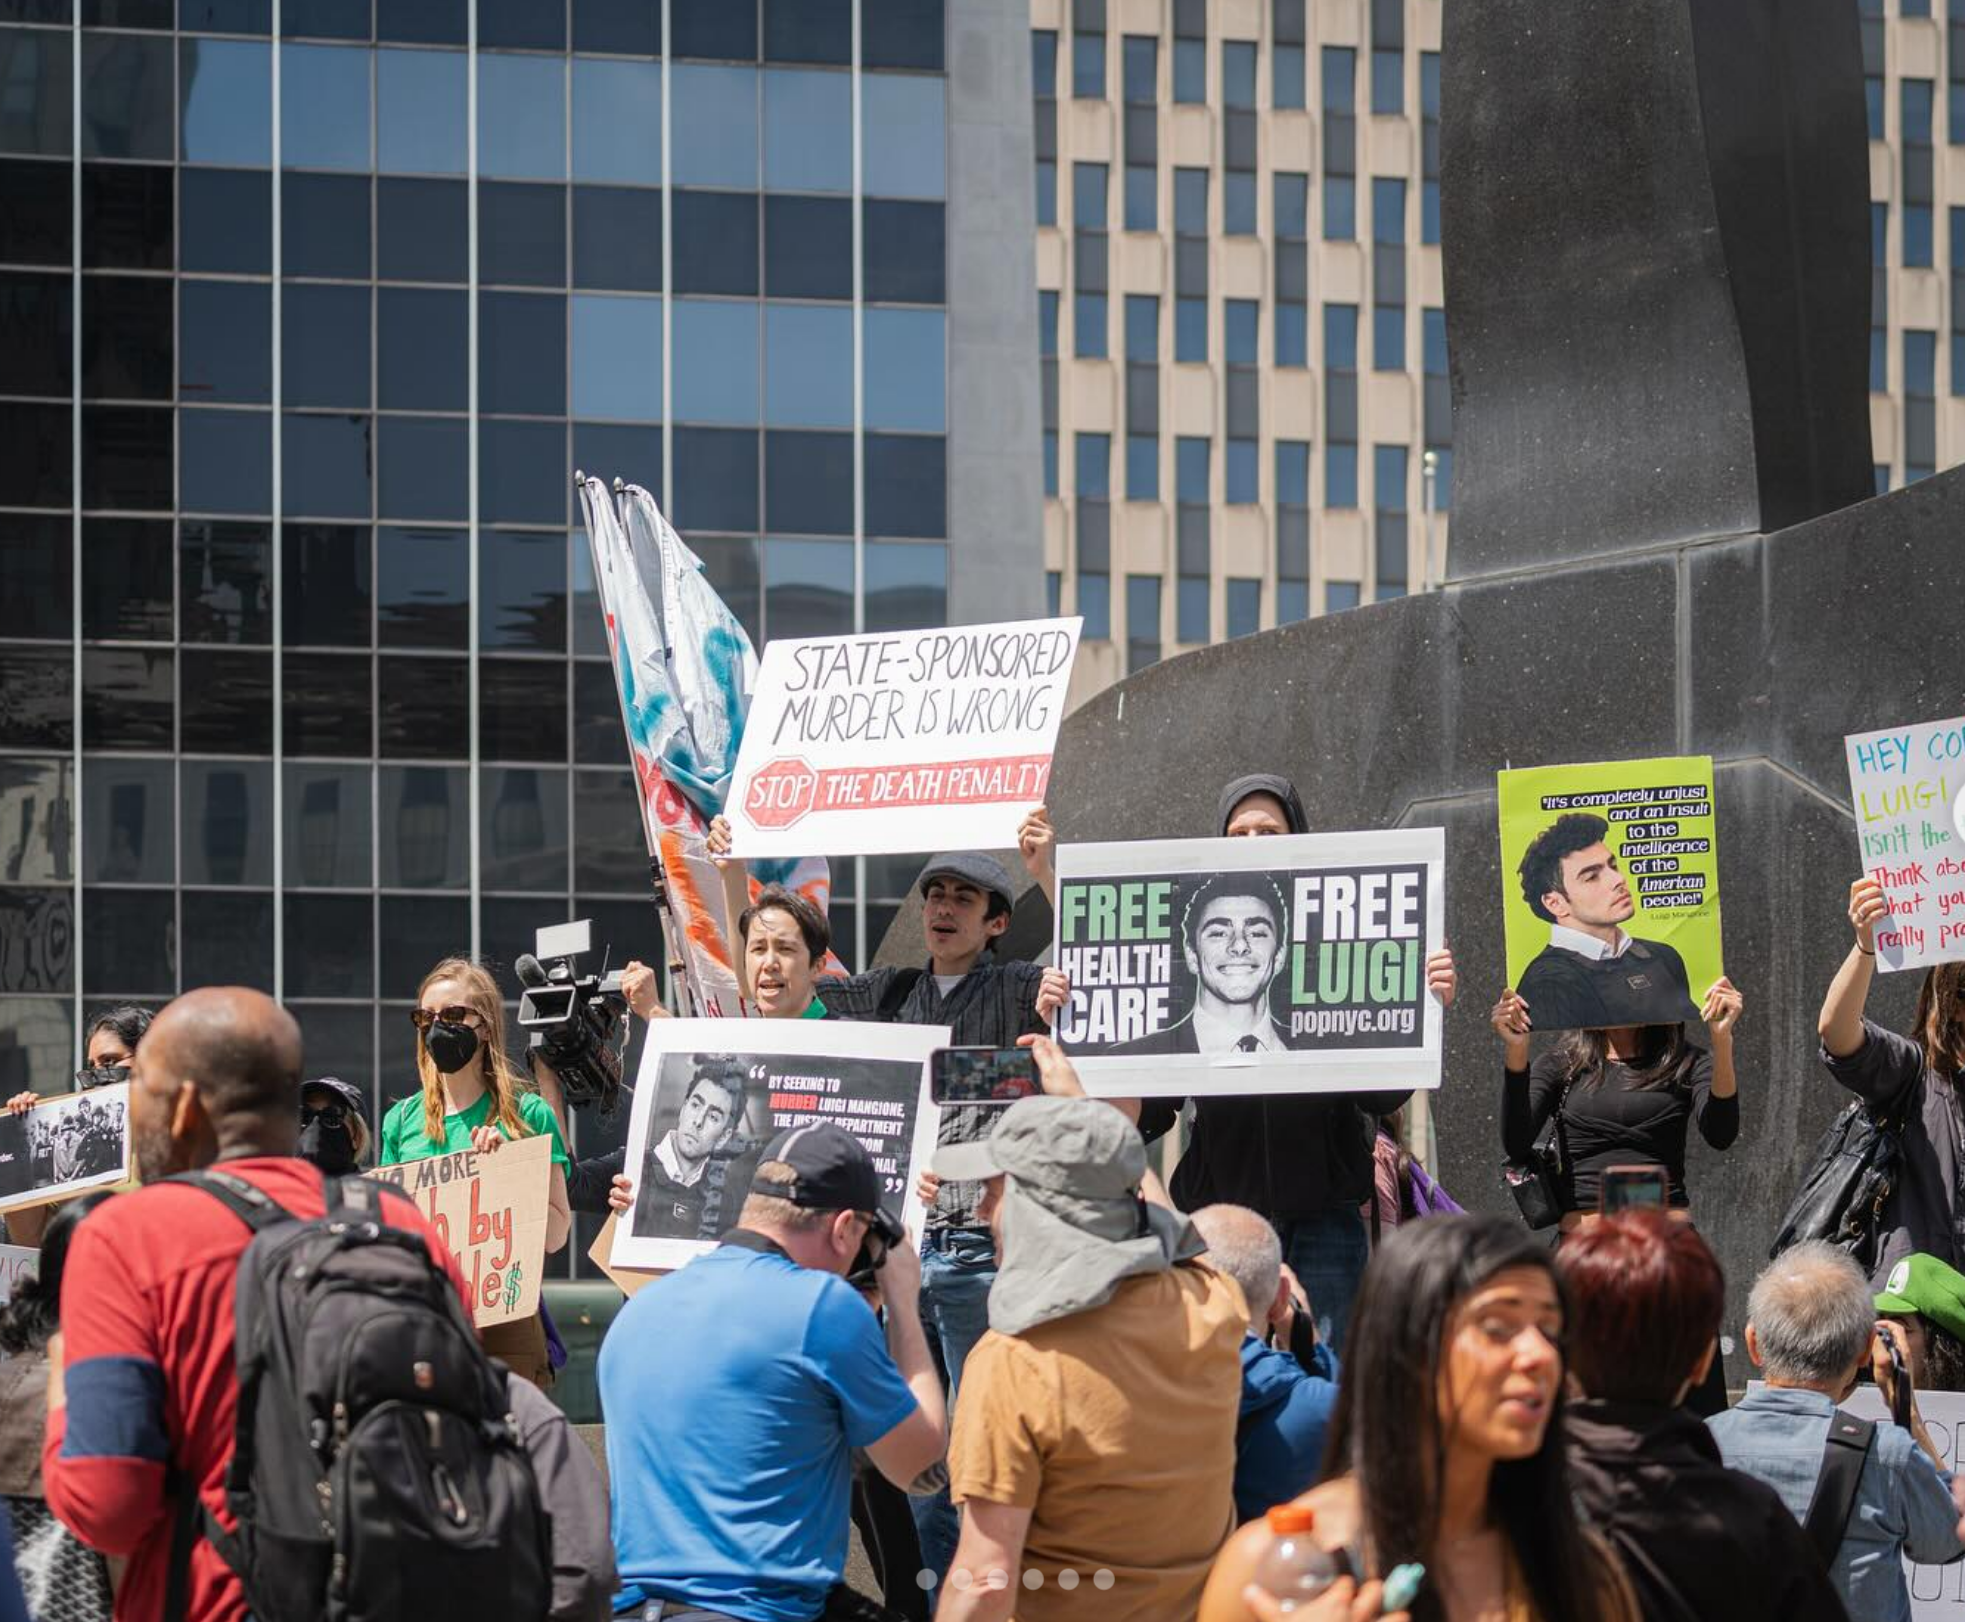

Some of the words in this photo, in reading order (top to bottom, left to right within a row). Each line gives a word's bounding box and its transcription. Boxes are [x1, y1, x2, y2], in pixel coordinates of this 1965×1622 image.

[785, 631, 1071, 692] STATE-SPONSORED
[772, 690, 904, 745] MURDER
[915, 689, 941, 734] IS
[947, 684, 1052, 735] WRONG
[1856, 735, 1910, 773] HEY
[750, 774, 812, 808] STOP
[826, 773, 865, 804] THE
[870, 770, 940, 802] DEATH
[947, 762, 1048, 797] PENALTY
[1572, 789, 1654, 806] completely
[1659, 785, 1705, 801] unjust
[1861, 776, 1948, 823] LUIGI
[1610, 806, 1639, 820] and
[1644, 807, 1663, 818] an
[1668, 803, 1708, 816] insult
[1628, 826, 1645, 838] to
[1650, 824, 1677, 837] the
[1922, 820, 1950, 849] the
[1622, 840, 1708, 856] intelligence
[1631, 860, 1647, 873] of
[1652, 859, 1677, 872] the
[1869, 862, 1929, 888] Think
[1640, 876, 1704, 892] American
[1062, 882, 1171, 942] FREE
[1293, 872, 1419, 942] FREE
[1877, 925, 1924, 955] really
[1062, 944, 1170, 987] HEALTH
[1291, 940, 1418, 1004] LUIGI
[1060, 987, 1169, 1044] CARE
[1291, 1008, 1415, 1038] popnyc.org
[769, 1076, 783, 1089] BY
[783, 1076, 825, 1091] SEEKING
[826, 1078, 841, 1093] TO
[774, 1113, 791, 1127] THE
[819, 1098, 846, 1113] LUIGI
[847, 1099, 905, 1118] MANGIONE,
[855, 1138, 884, 1153] ROM
[415, 1153, 479, 1192] MORE
[469, 1178, 512, 1269] by
